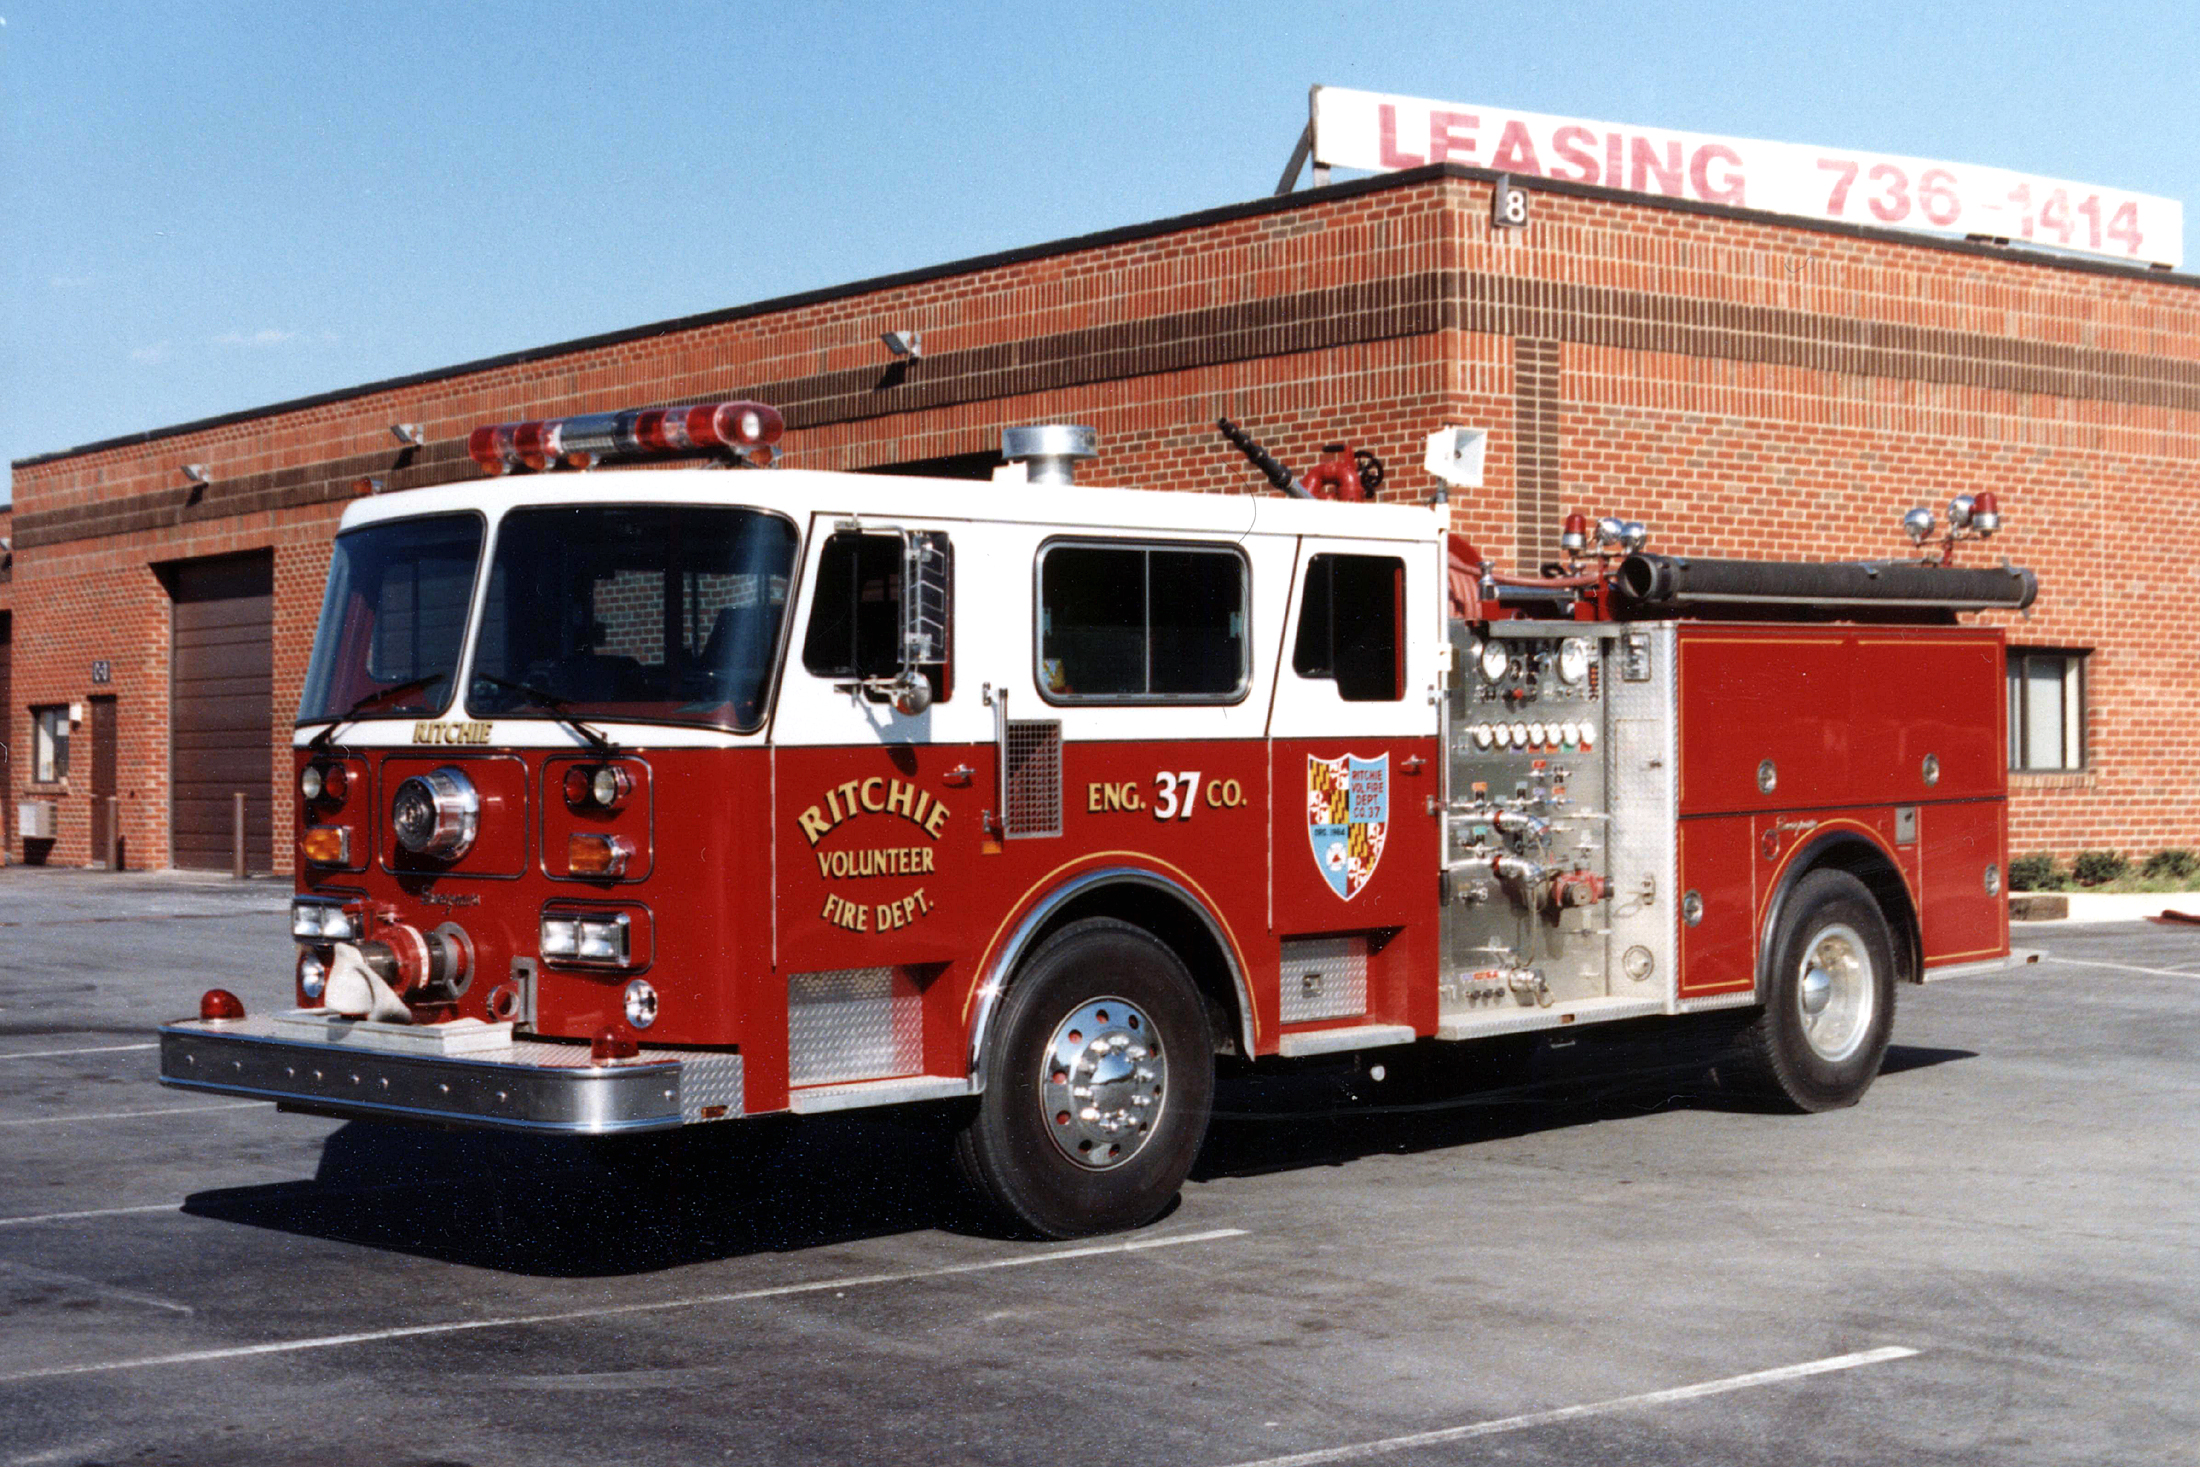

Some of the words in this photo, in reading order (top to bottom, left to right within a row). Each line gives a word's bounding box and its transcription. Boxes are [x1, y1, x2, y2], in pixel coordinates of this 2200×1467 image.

[1378, 103, 1747, 207] LEASING
[1506, 190, 1526, 223] 8
[412, 721, 494, 744] RITCHIE
[1351, 770, 1382, 781] RITCHIE
[797, 776, 951, 848] RITCHIE
[1088, 781, 1147, 813] ENG.
[1153, 771, 1202, 821] 37
[1206, 778, 1248, 808] CO.
[1367, 806, 1381, 818] 37
[816, 847, 935, 878] VOLUNTEER
[821, 892, 869, 933] FIRE
[876, 886, 935, 934] DEPT.
